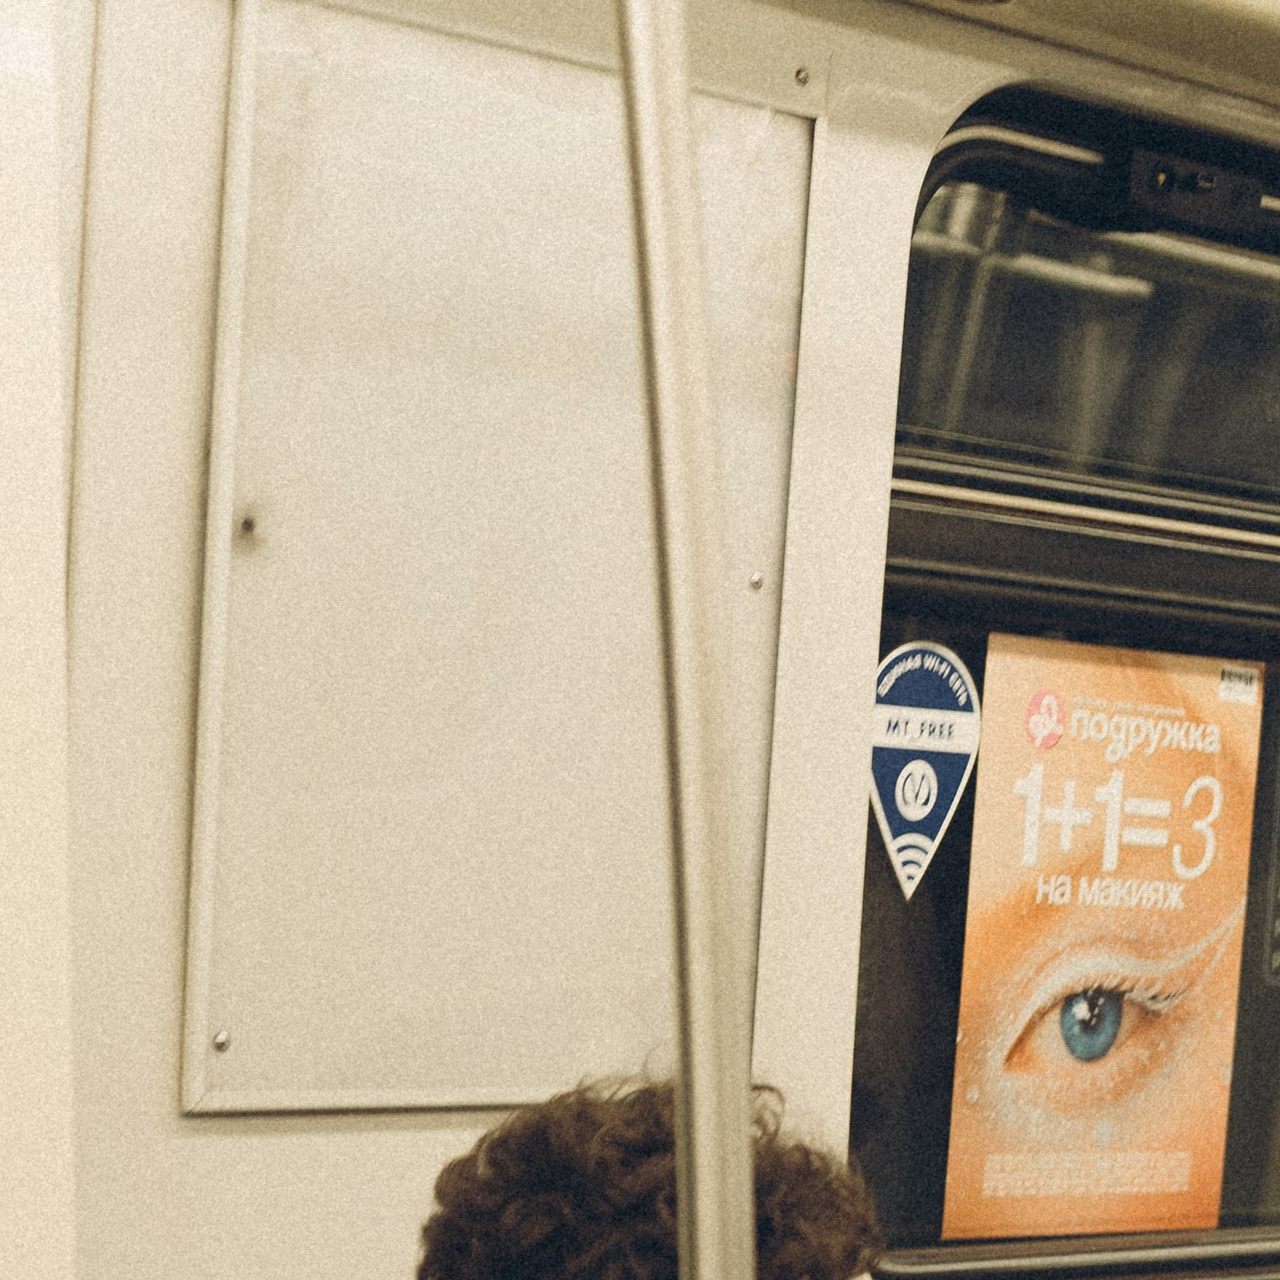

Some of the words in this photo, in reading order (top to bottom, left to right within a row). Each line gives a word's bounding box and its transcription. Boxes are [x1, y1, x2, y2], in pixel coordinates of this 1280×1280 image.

[1070, 709, 1220, 762] подружка
[1012, 763, 1223, 881] 1+1=3
[1035, 874, 1072, 905] на
[1077, 876, 1185, 911] макияж
